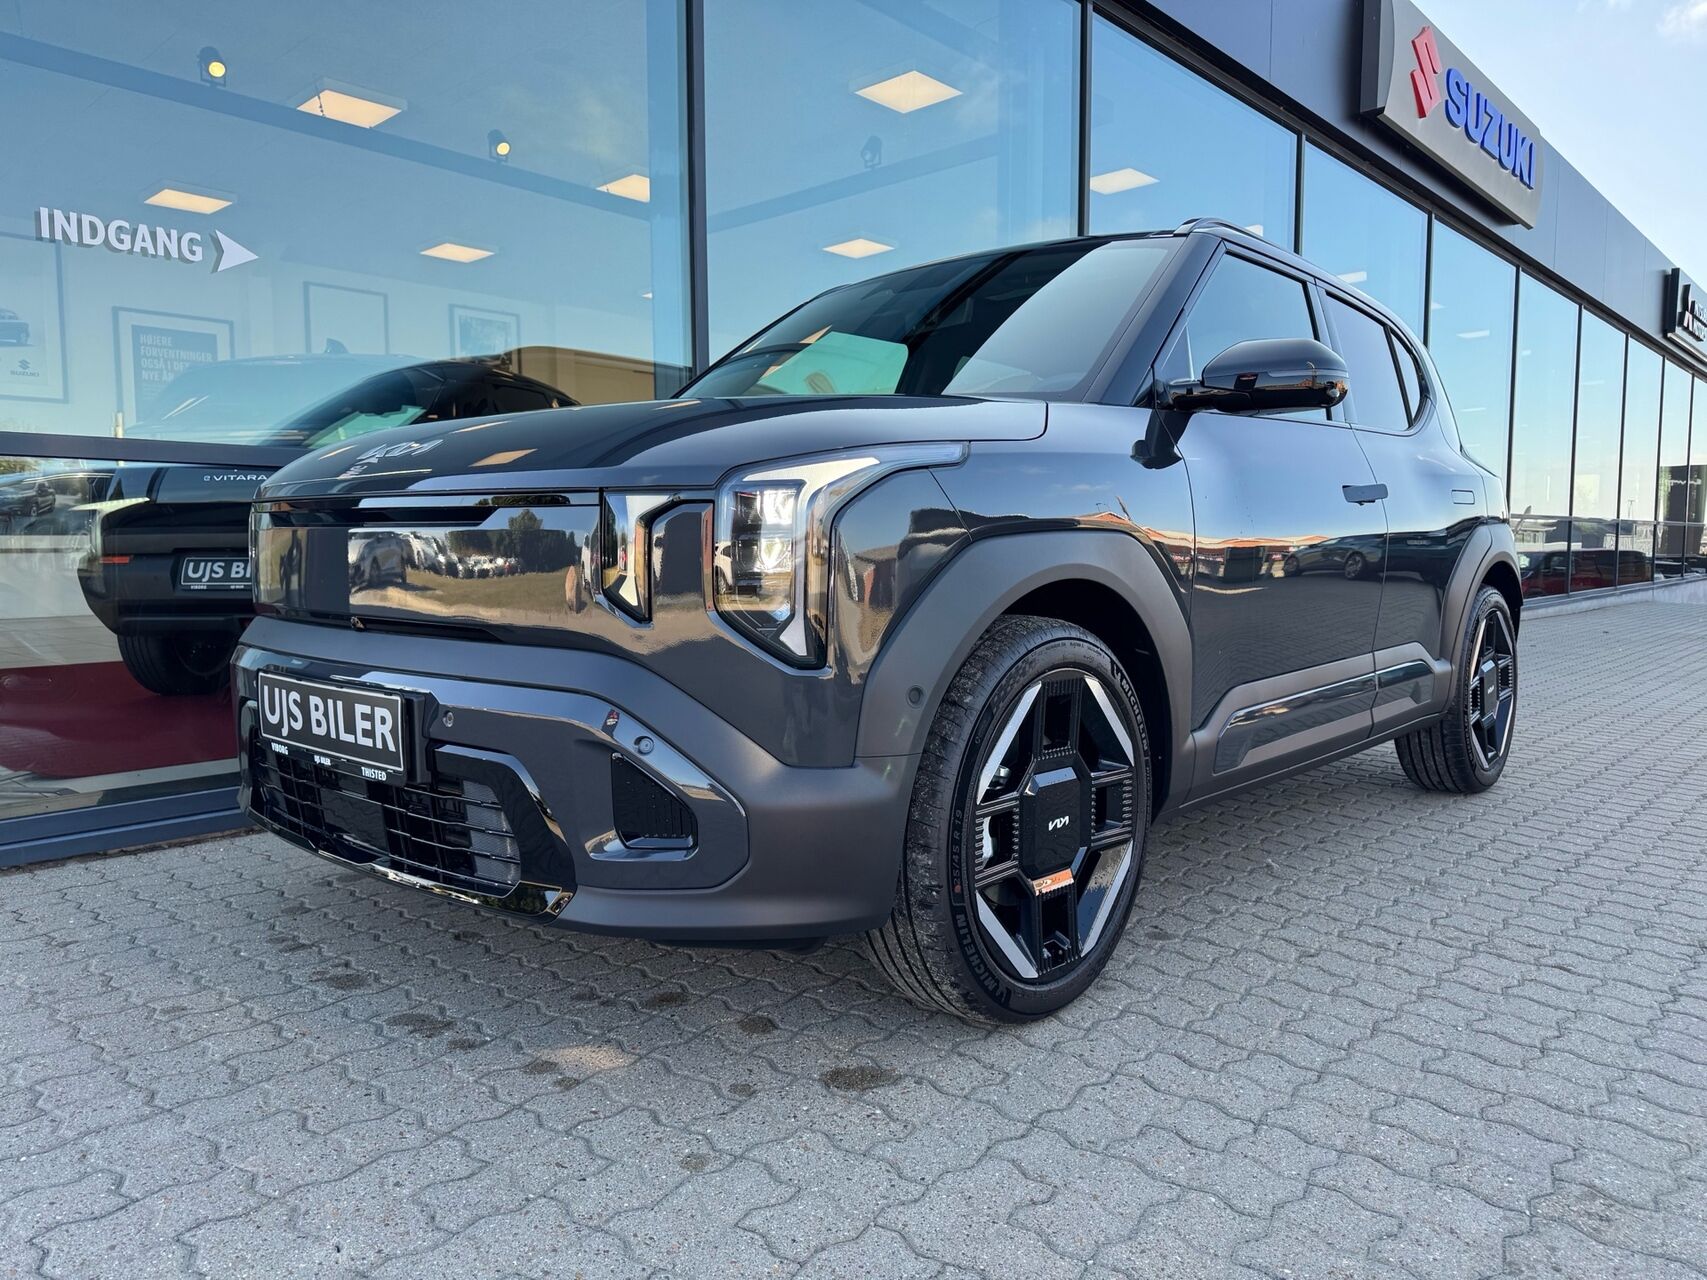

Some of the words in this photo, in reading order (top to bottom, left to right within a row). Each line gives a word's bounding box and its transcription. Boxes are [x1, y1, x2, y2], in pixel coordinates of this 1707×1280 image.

[1444, 68, 1536, 190] SUZUKI
[37, 206, 203, 263] INDGANG
[140, 346, 213, 362] FORVENTNINGER
[187, 562, 225, 582] UJS
[263, 685, 303, 737] UJS
[309, 695, 396, 753] BILER
[1121, 678, 1149, 752] MICHELIN
[271, 742, 289, 756] VIBORG
[361, 766, 387, 781] THISTED
[956, 914, 998, 991] MICHELIN
